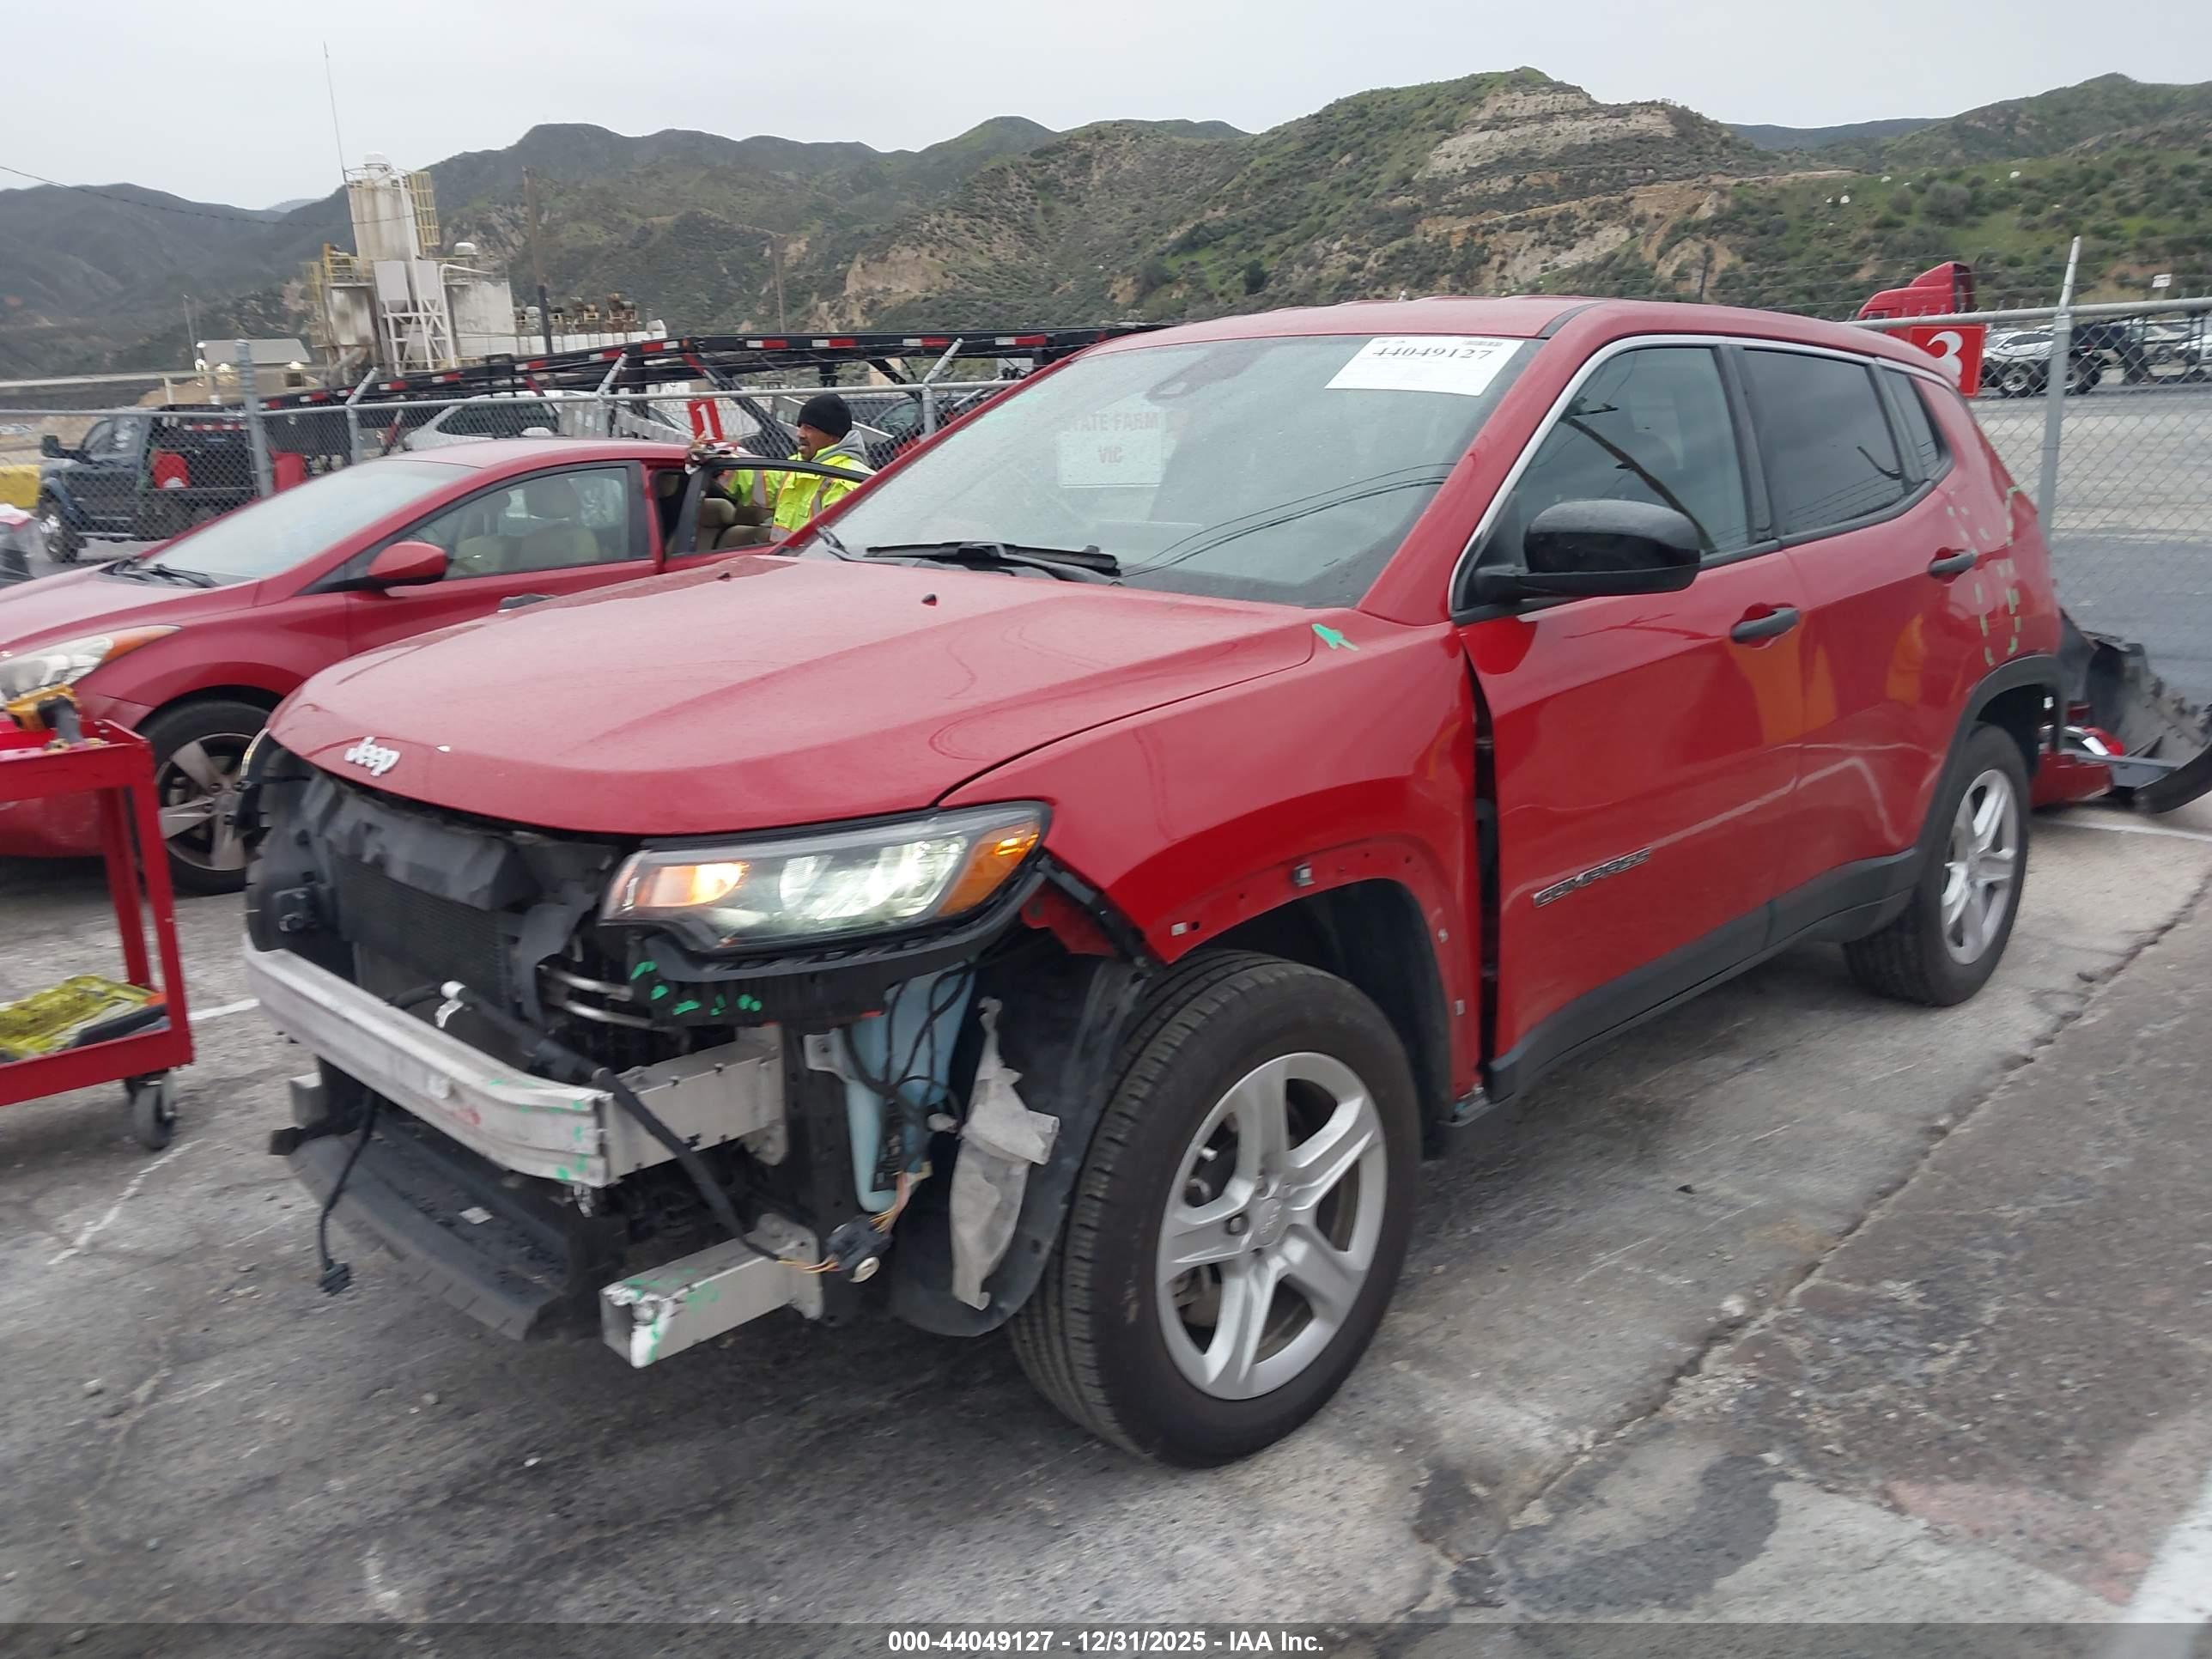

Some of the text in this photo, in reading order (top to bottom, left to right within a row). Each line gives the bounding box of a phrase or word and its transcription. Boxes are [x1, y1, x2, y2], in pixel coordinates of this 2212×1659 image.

[1372, 346, 1496, 361] 44049127
[696, 403, 719, 441] 1
[343, 736, 402, 777] Jeep
